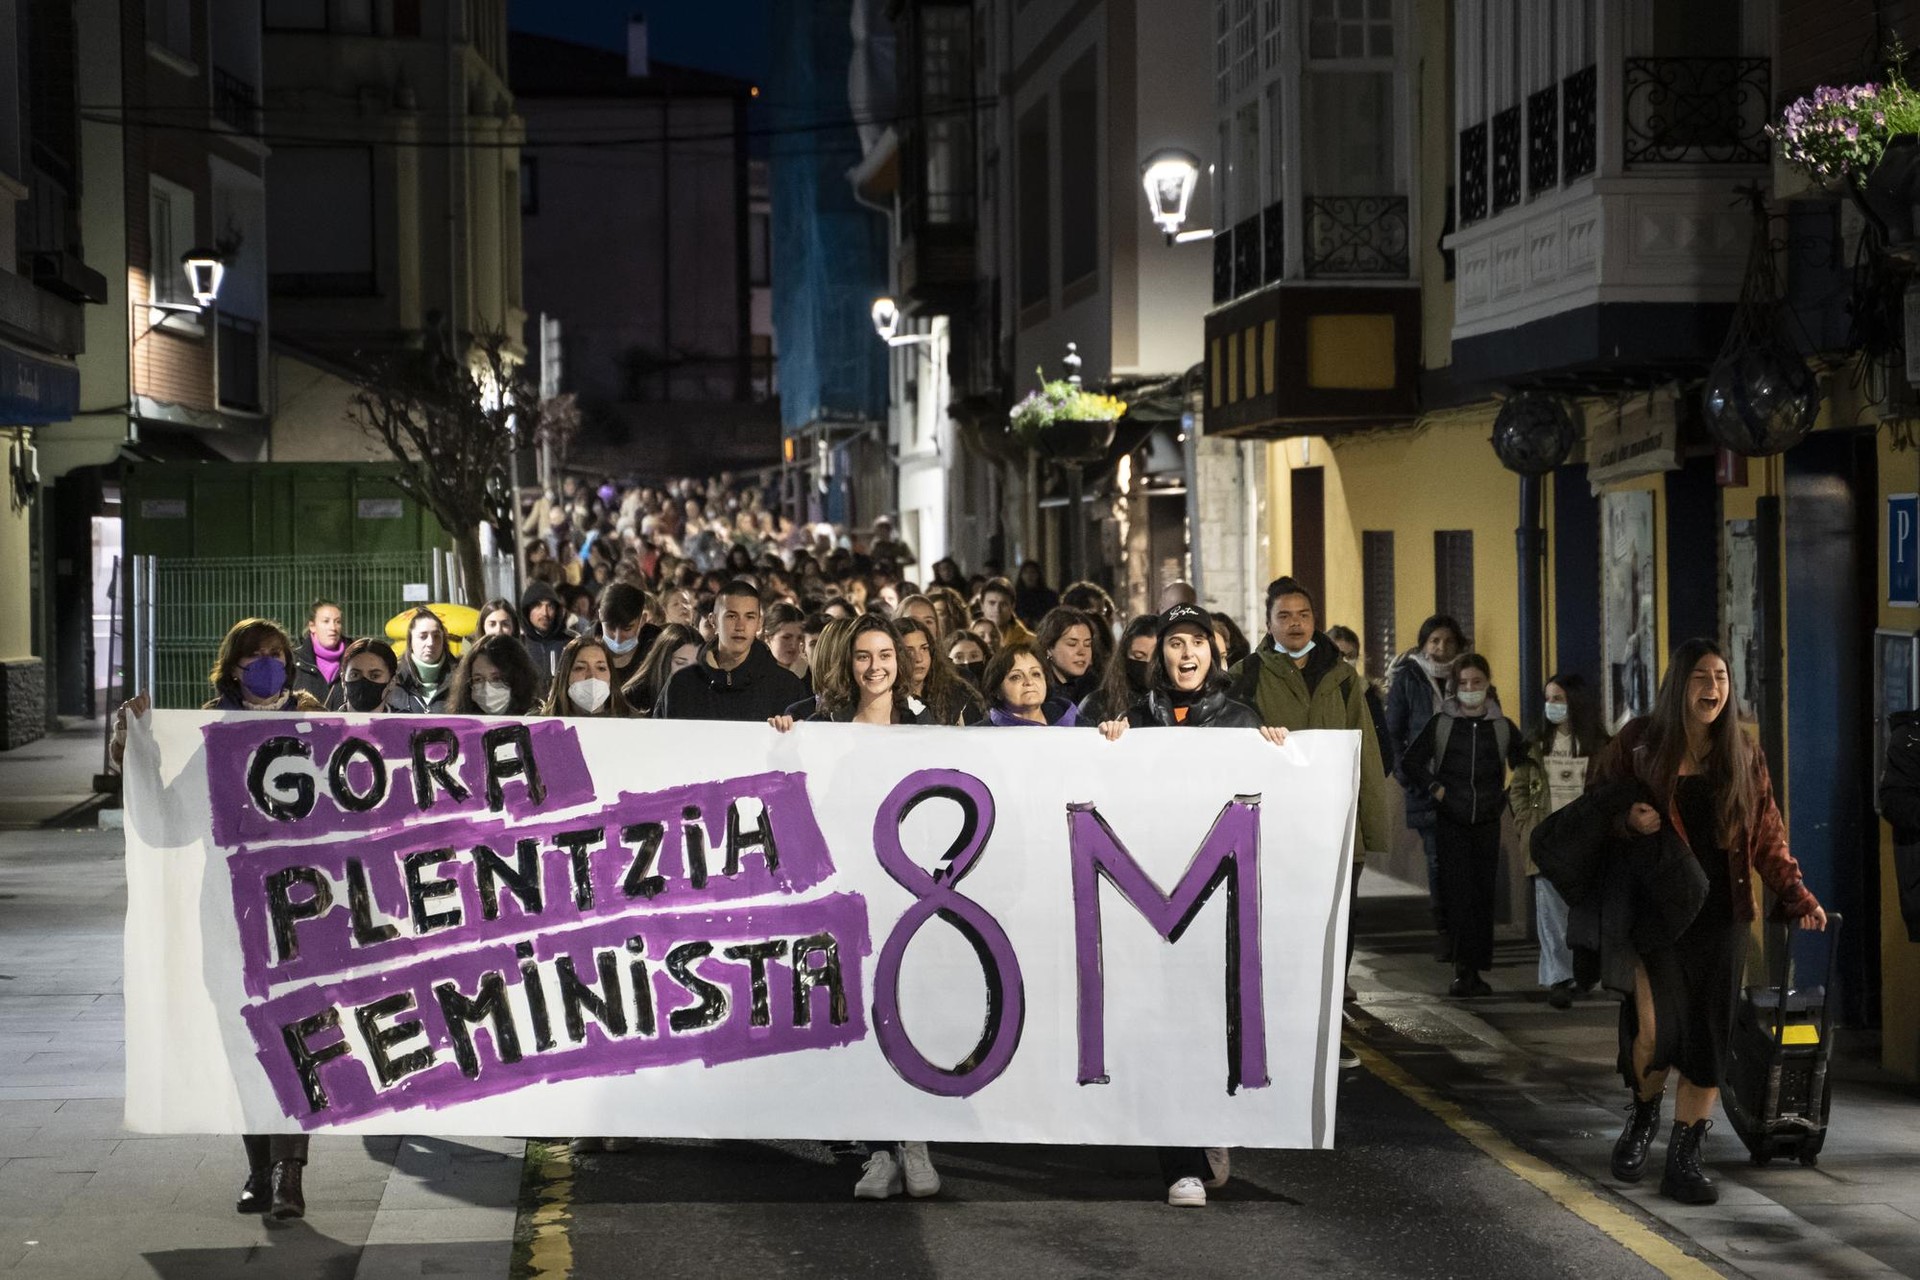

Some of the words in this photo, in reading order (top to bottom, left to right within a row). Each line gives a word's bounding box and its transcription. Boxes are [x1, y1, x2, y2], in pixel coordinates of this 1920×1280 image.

[1897, 510, 1910, 563] P
[247, 724, 547, 821] GORA
[872, 768, 1271, 1097] 8M
